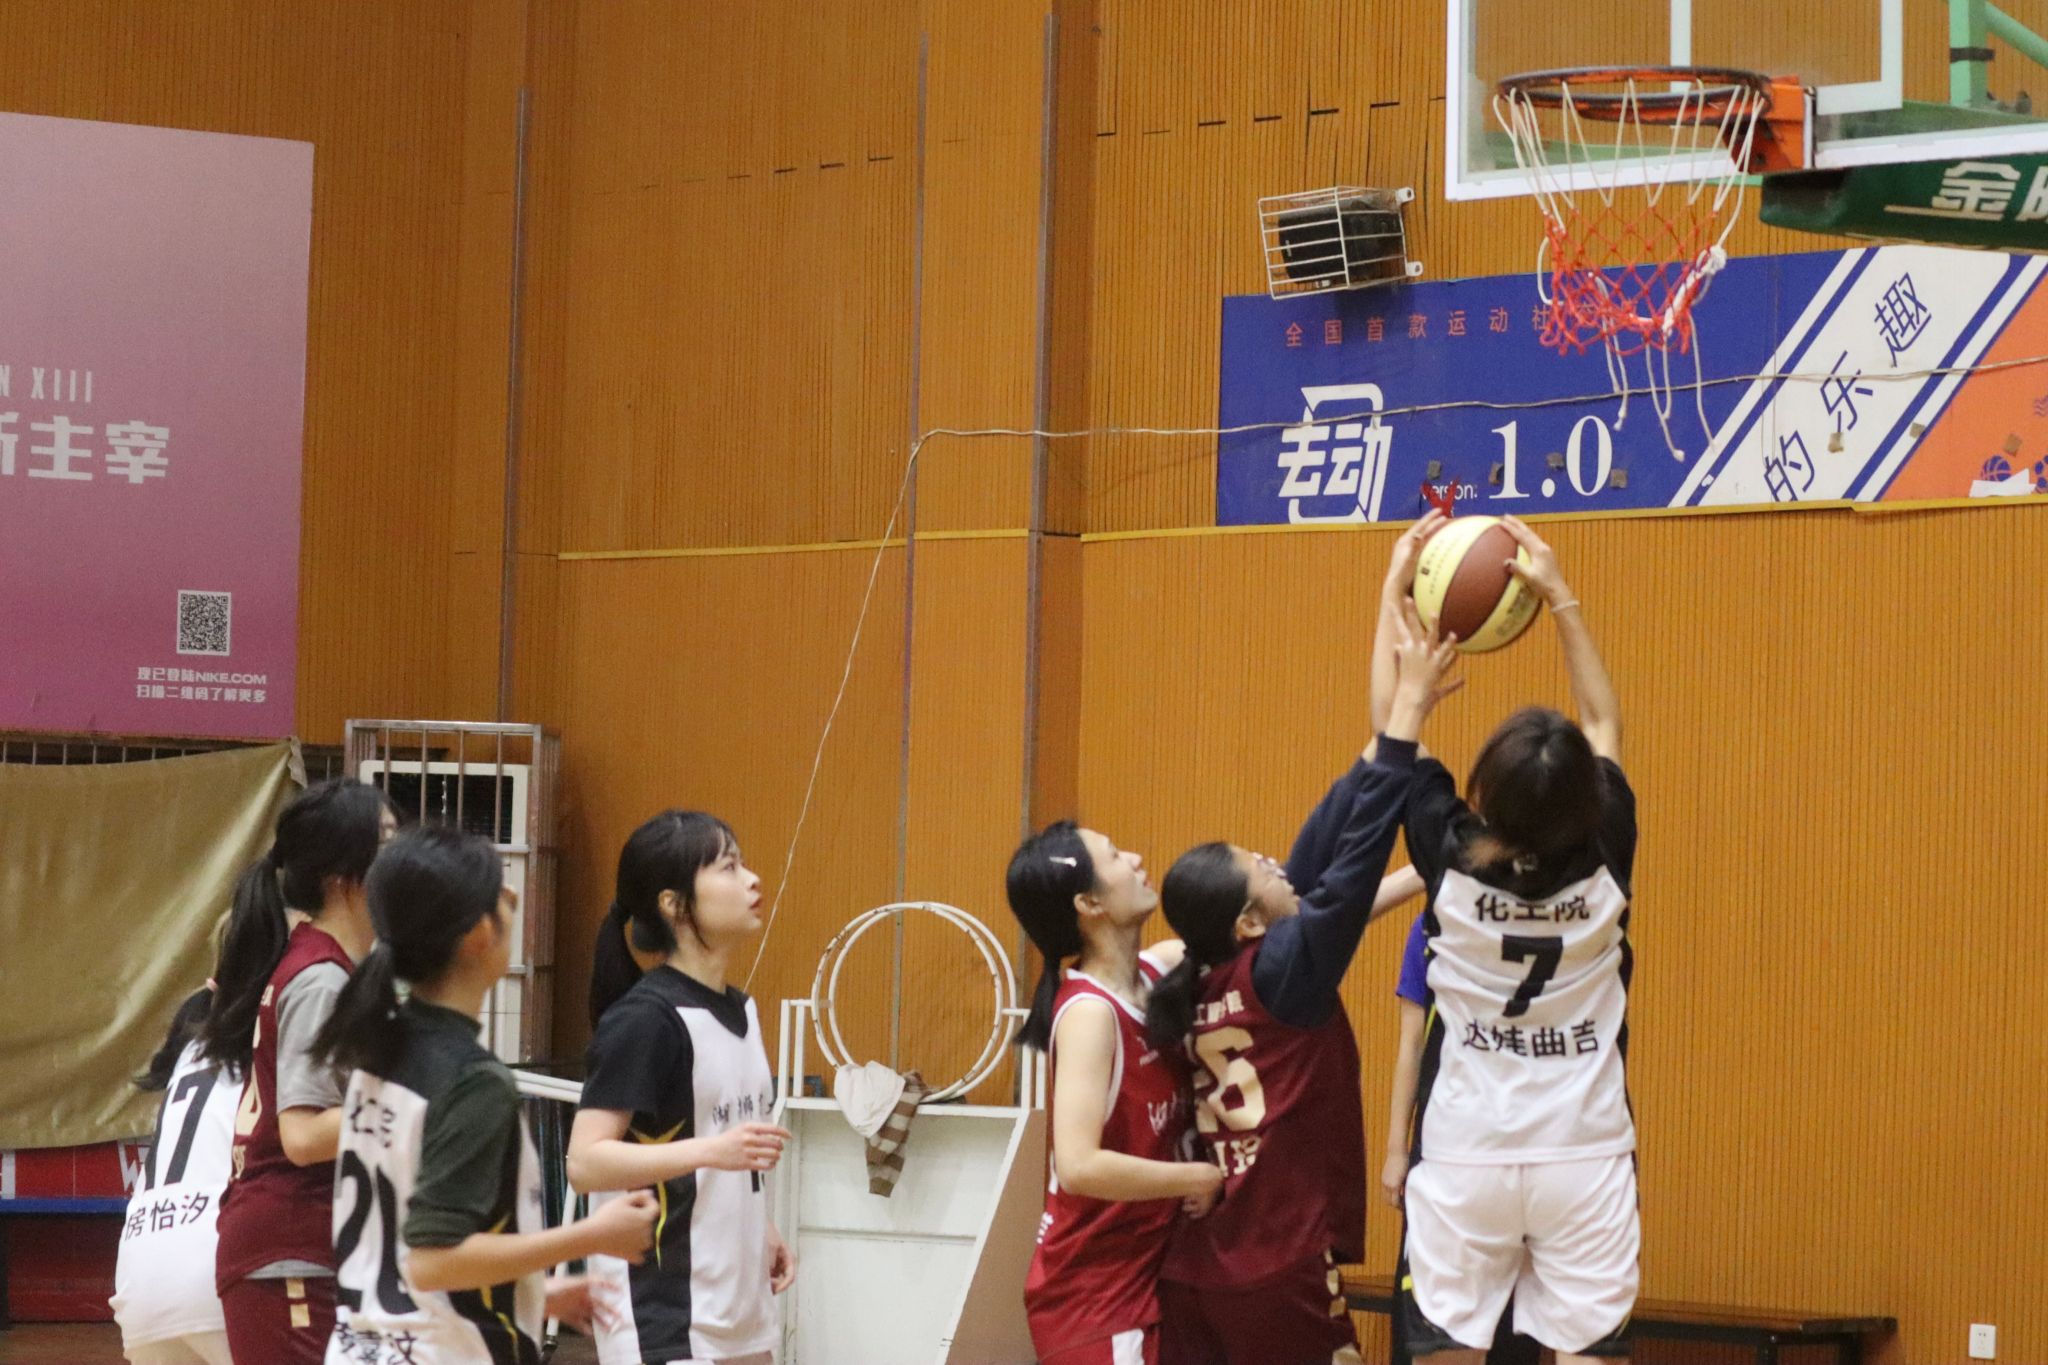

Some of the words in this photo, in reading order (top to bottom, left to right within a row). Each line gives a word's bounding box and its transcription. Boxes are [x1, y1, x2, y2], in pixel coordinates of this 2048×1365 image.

[1489, 415, 1612, 499] 1.0
[1474, 892, 1590, 923] 化工院
[1501, 933, 1563, 1017] 7
[1463, 1017, 1599, 1059] 达娃曲吉
[125, 1192, 210, 1241] 房怡汐
